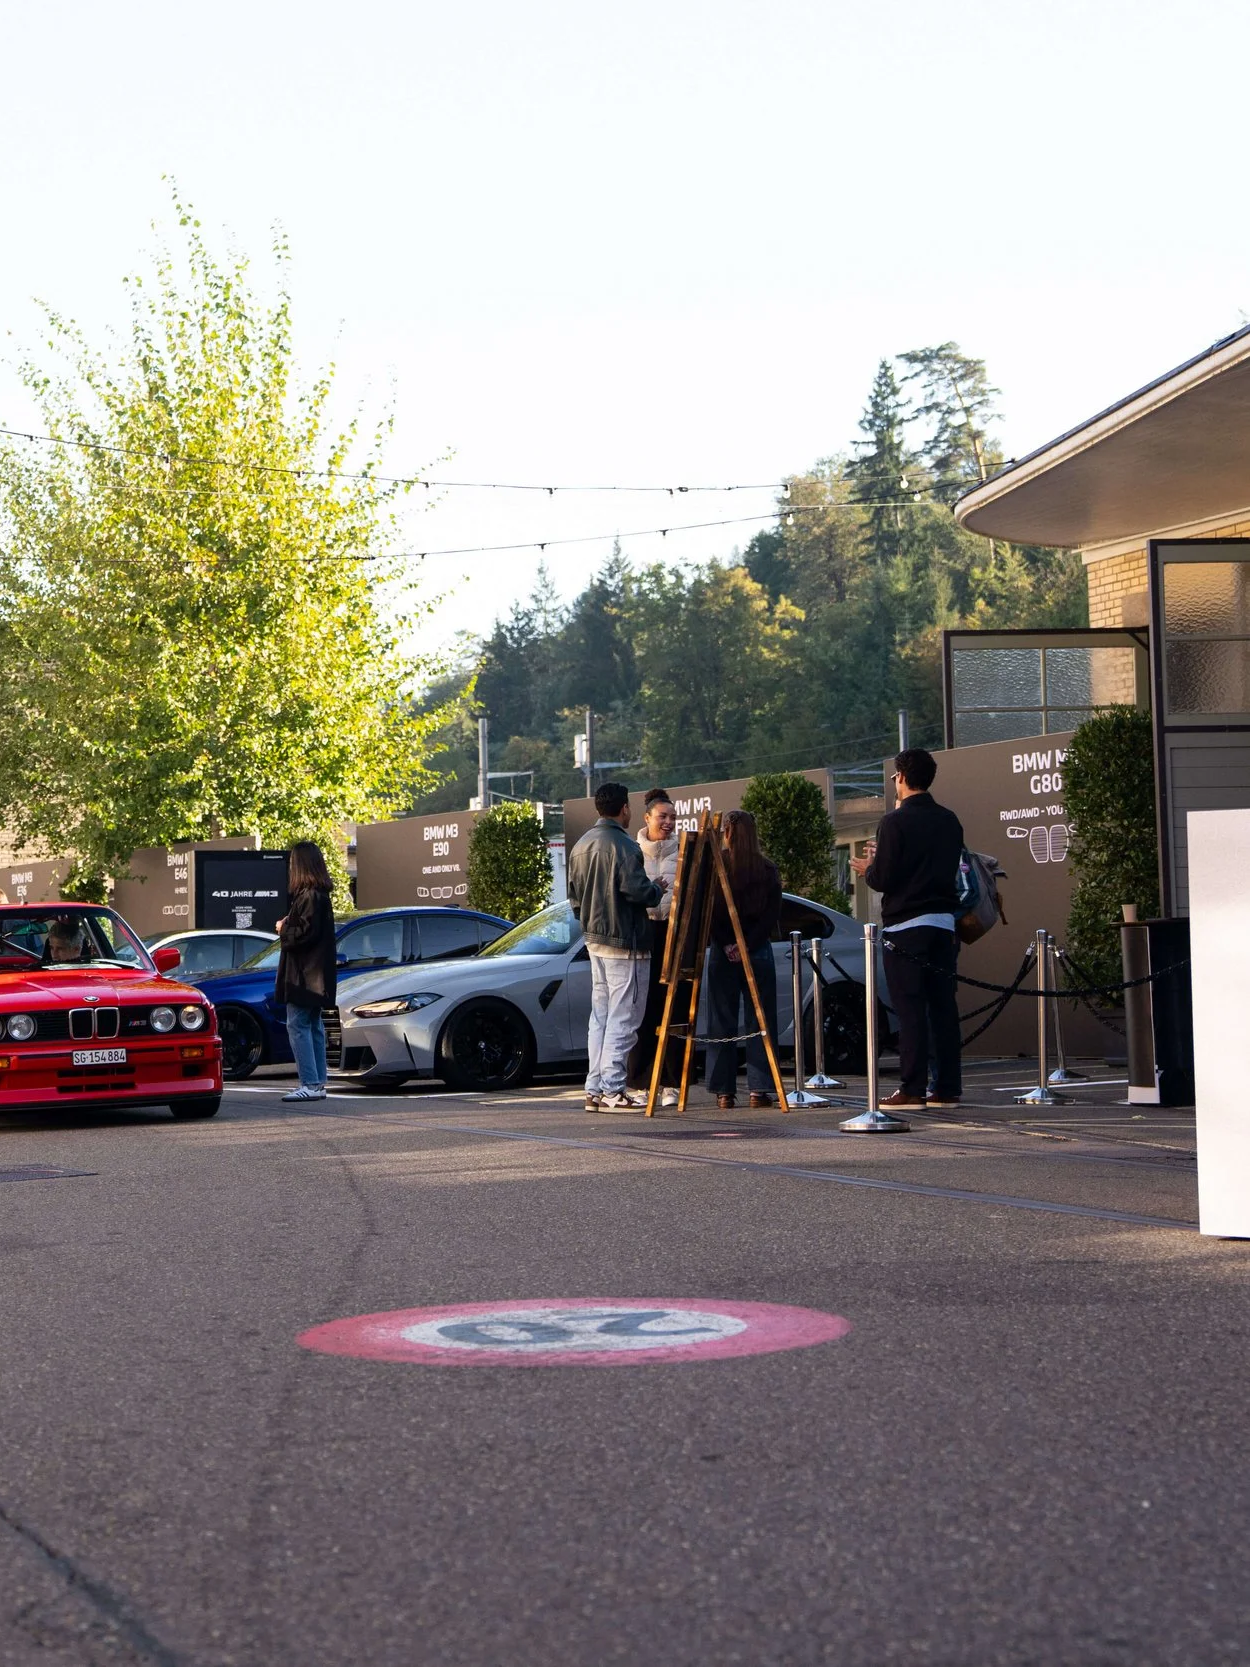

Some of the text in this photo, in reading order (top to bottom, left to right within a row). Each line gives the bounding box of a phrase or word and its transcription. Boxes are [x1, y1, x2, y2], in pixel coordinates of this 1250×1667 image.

[1012, 750, 1051, 773] BMW
[1030, 772, 1062, 794] G80
[674, 796, 711, 816] MW M3
[999, 807, 1040, 821] RWD/AWD
[423, 823, 459, 841] BMW M3
[675, 818, 698, 836] F80
[432, 841, 450, 857] E90
[167, 853, 184, 867] BMW
[12, 874, 24, 884] BMW
[174, 867, 188, 880] E46
[212, 890, 229, 898] 40
[230, 890, 253, 898] JAHRE
